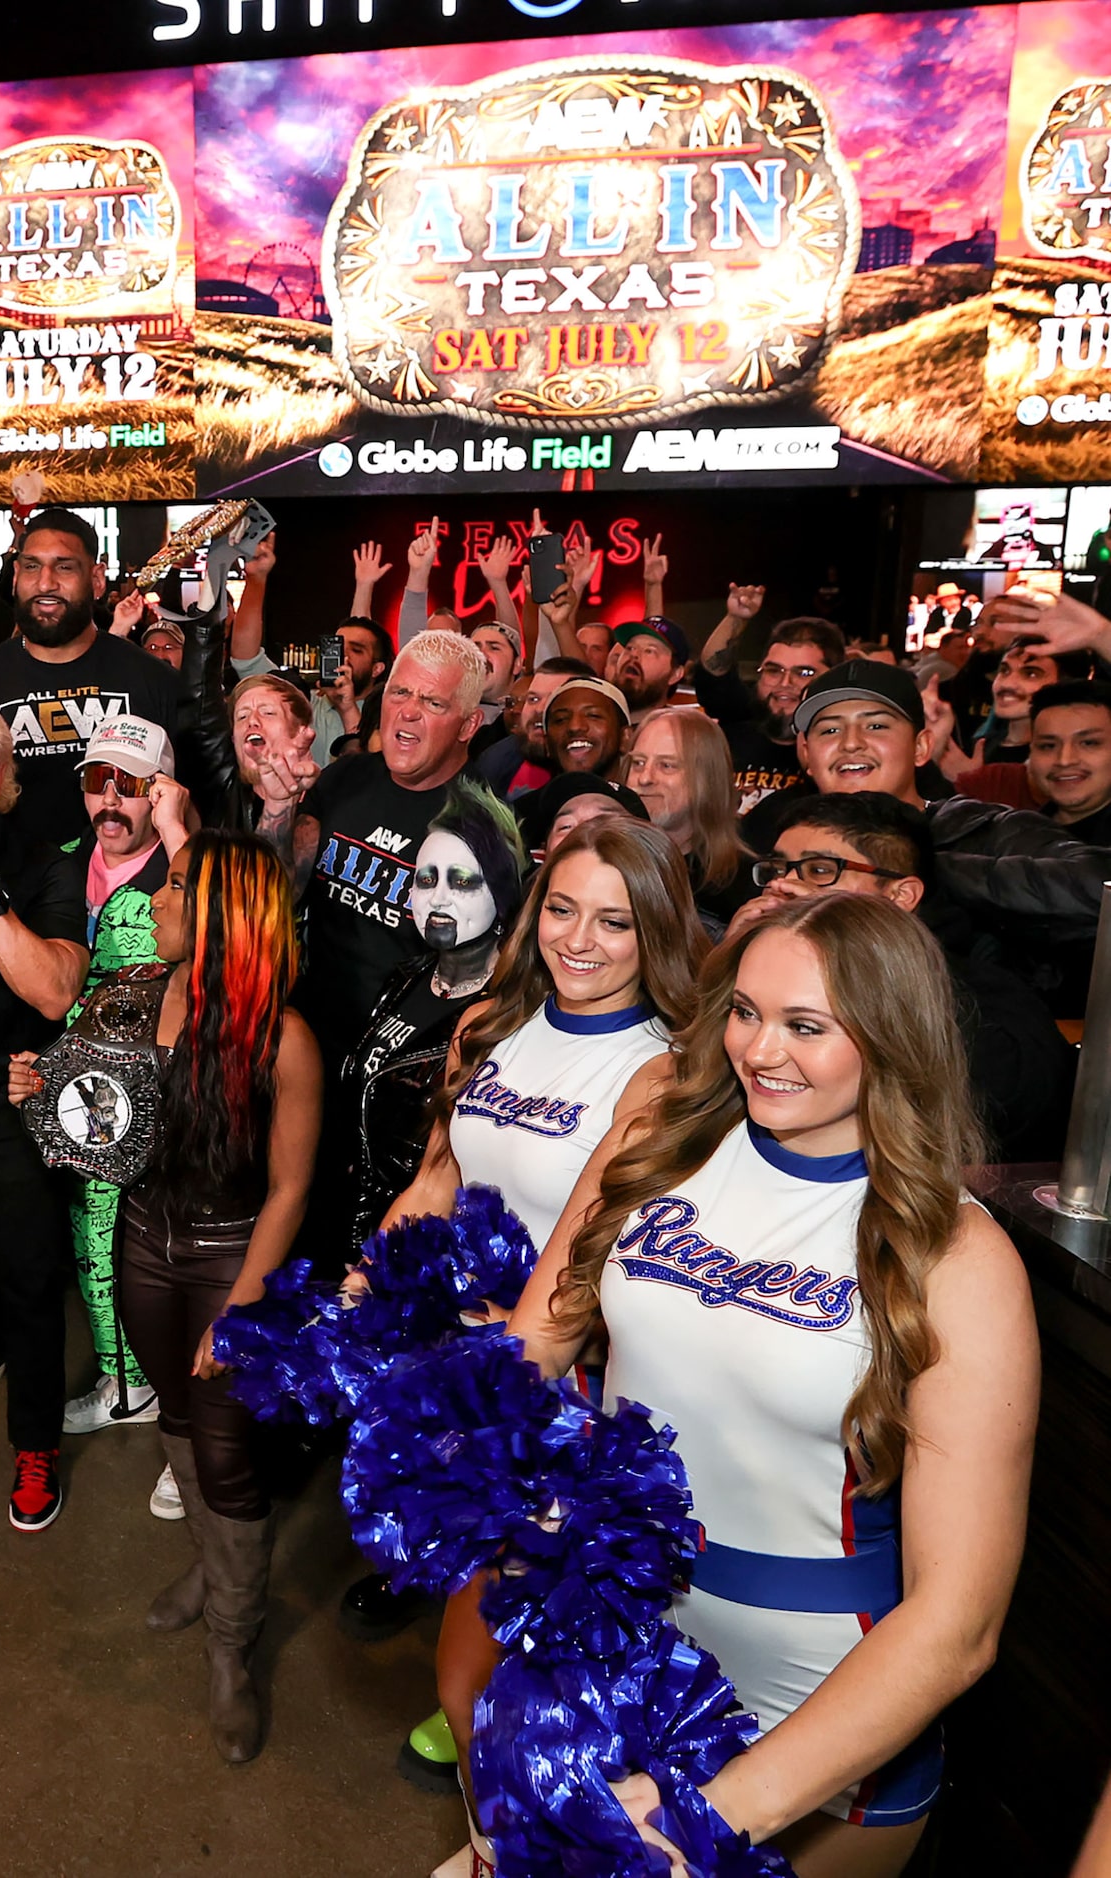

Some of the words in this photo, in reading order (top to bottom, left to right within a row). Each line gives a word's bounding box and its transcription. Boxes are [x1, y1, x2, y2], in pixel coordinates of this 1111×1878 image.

[524, 94, 669, 152] AEW
[94, 192, 163, 247] IN
[394, 172, 630, 265] ALL
[656, 159, 788, 253] IN
[455, 262, 716, 317] TEXAS
[433, 327, 529, 375] SAT
[545, 322, 658, 376] JULY
[678, 319, 731, 365] 12
[102, 352, 157, 402] 12
[63, 423, 107, 450] Life
[110, 422, 166, 447] Field
[357, 438, 457, 474] Globe
[463, 437, 527, 473] Life
[532, 435, 612, 471] Field
[26, 691, 55, 702] ALL
[57, 686, 100, 699] ELITE
[10, 698, 123, 747] AEW
[316, 837, 384, 895] ALL
[365, 826, 413, 854] AEW
[328, 881, 402, 929] TEXAS
[455, 1060, 590, 1134] Rangers
[610, 1195, 860, 1329] Rangers
